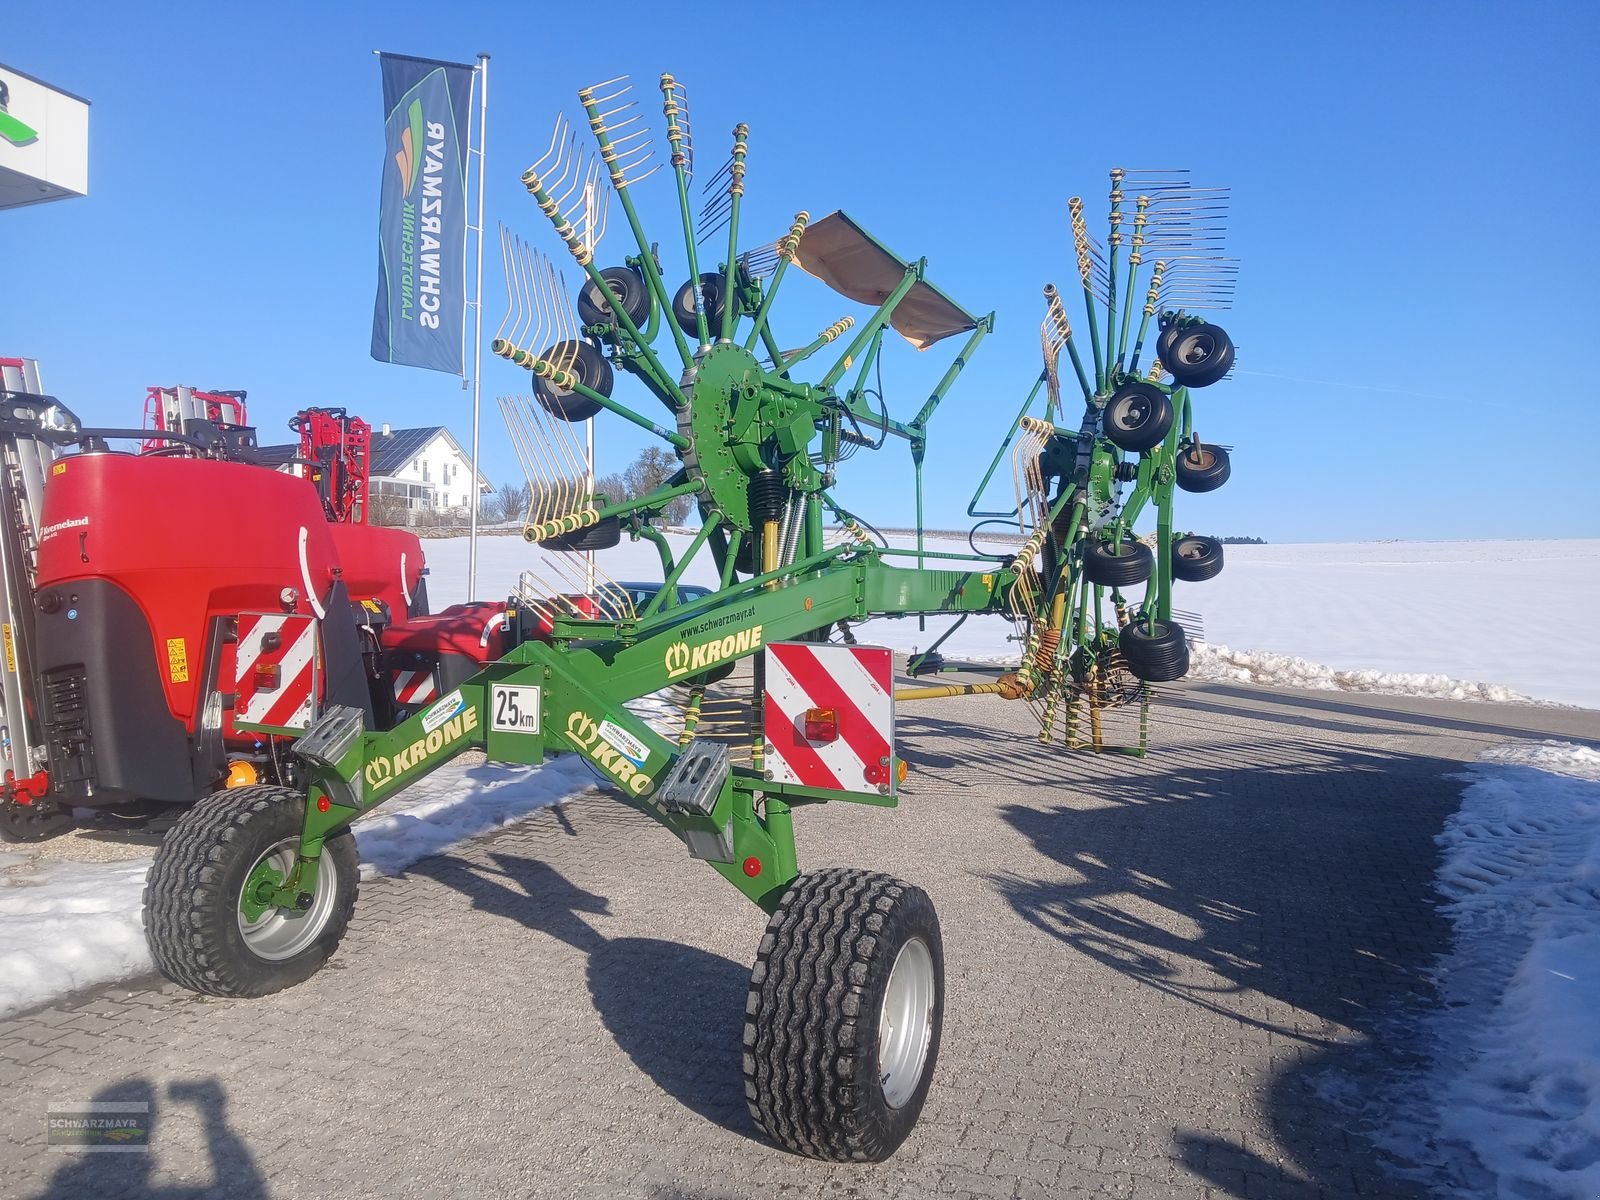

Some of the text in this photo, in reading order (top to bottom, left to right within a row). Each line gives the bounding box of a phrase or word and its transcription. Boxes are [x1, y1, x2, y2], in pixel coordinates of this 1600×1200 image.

[680, 605, 756, 639] www.schwarzmayr.at
[691, 625, 763, 670] KRONE
[496, 689, 534, 728] 25 km
[393, 705, 479, 777] KRONE
[591, 741, 668, 816] KRO
